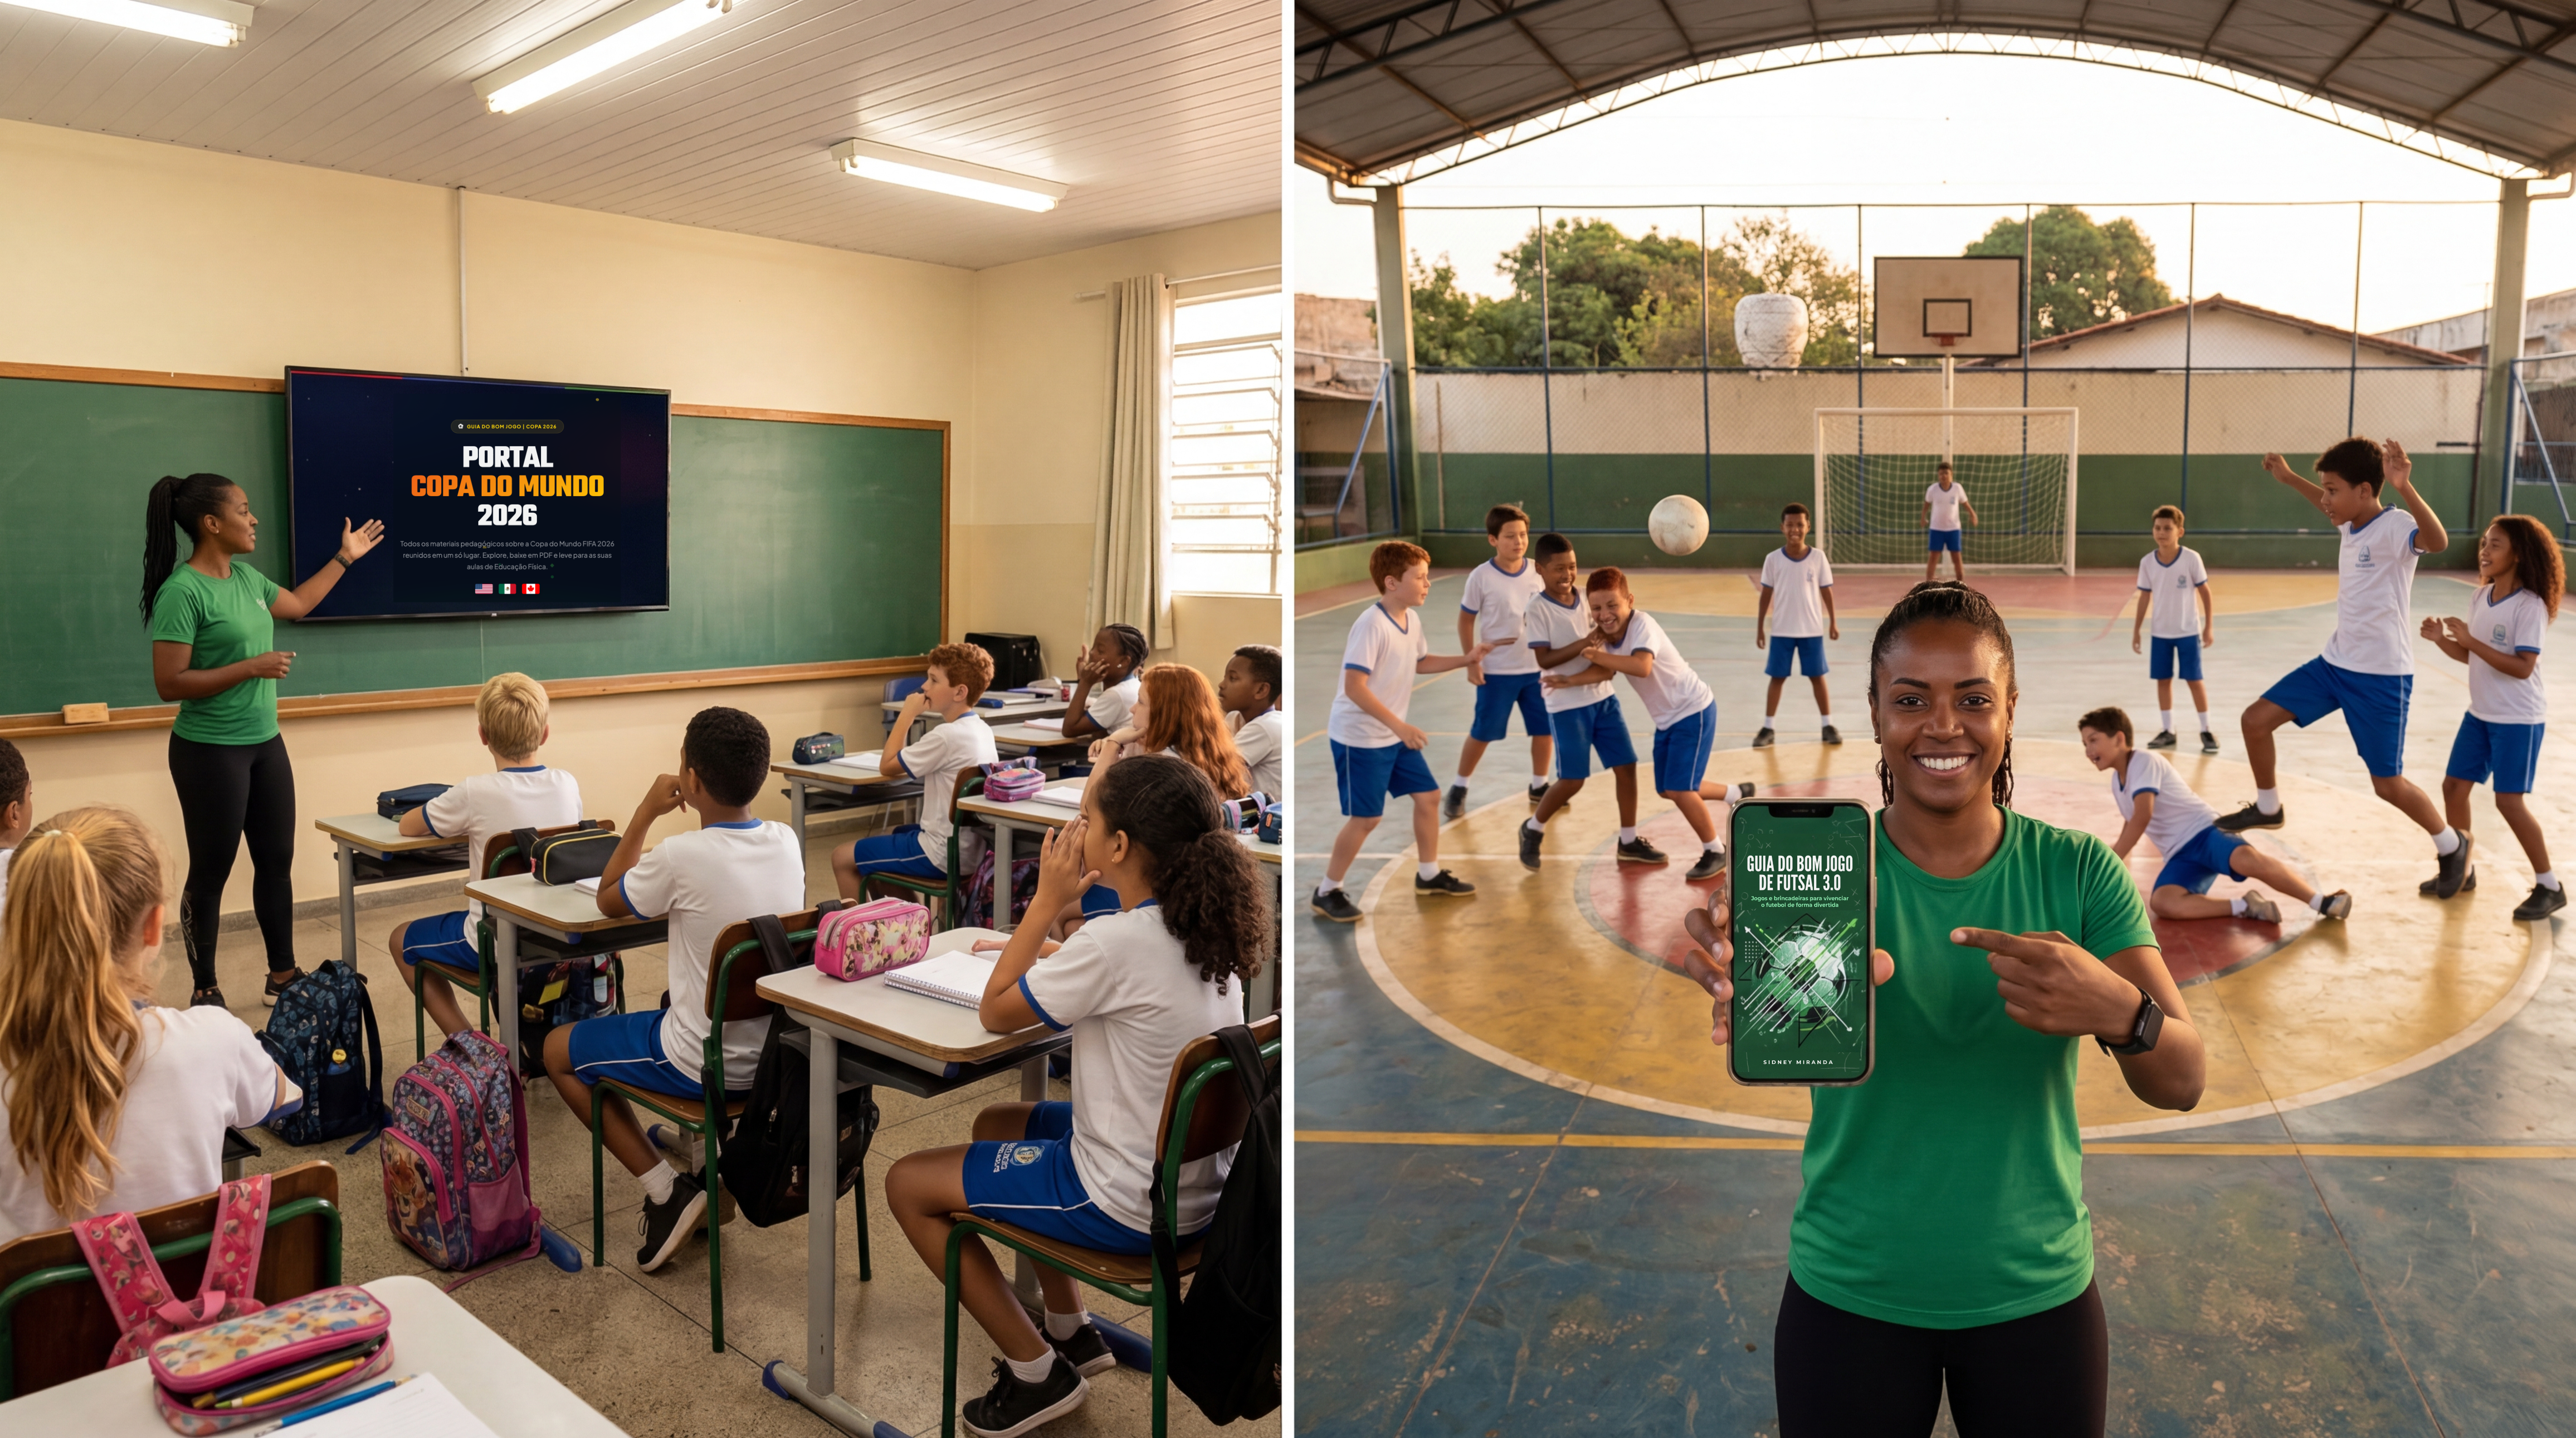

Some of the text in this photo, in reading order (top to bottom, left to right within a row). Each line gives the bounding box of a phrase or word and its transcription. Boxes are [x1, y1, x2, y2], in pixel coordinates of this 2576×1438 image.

[463, 446, 553, 467] PORTAL
[411, 475, 604, 496] COPA DO MUNDO
[478, 504, 537, 525] 2026
[461, 540, 505, 549] pedagógicos
[494, 563, 527, 572] Educação
[1747, 855, 1852, 872] GUIA DO BOM JOGO
[1759, 874, 1840, 890] DE FUTSAL 3.0
